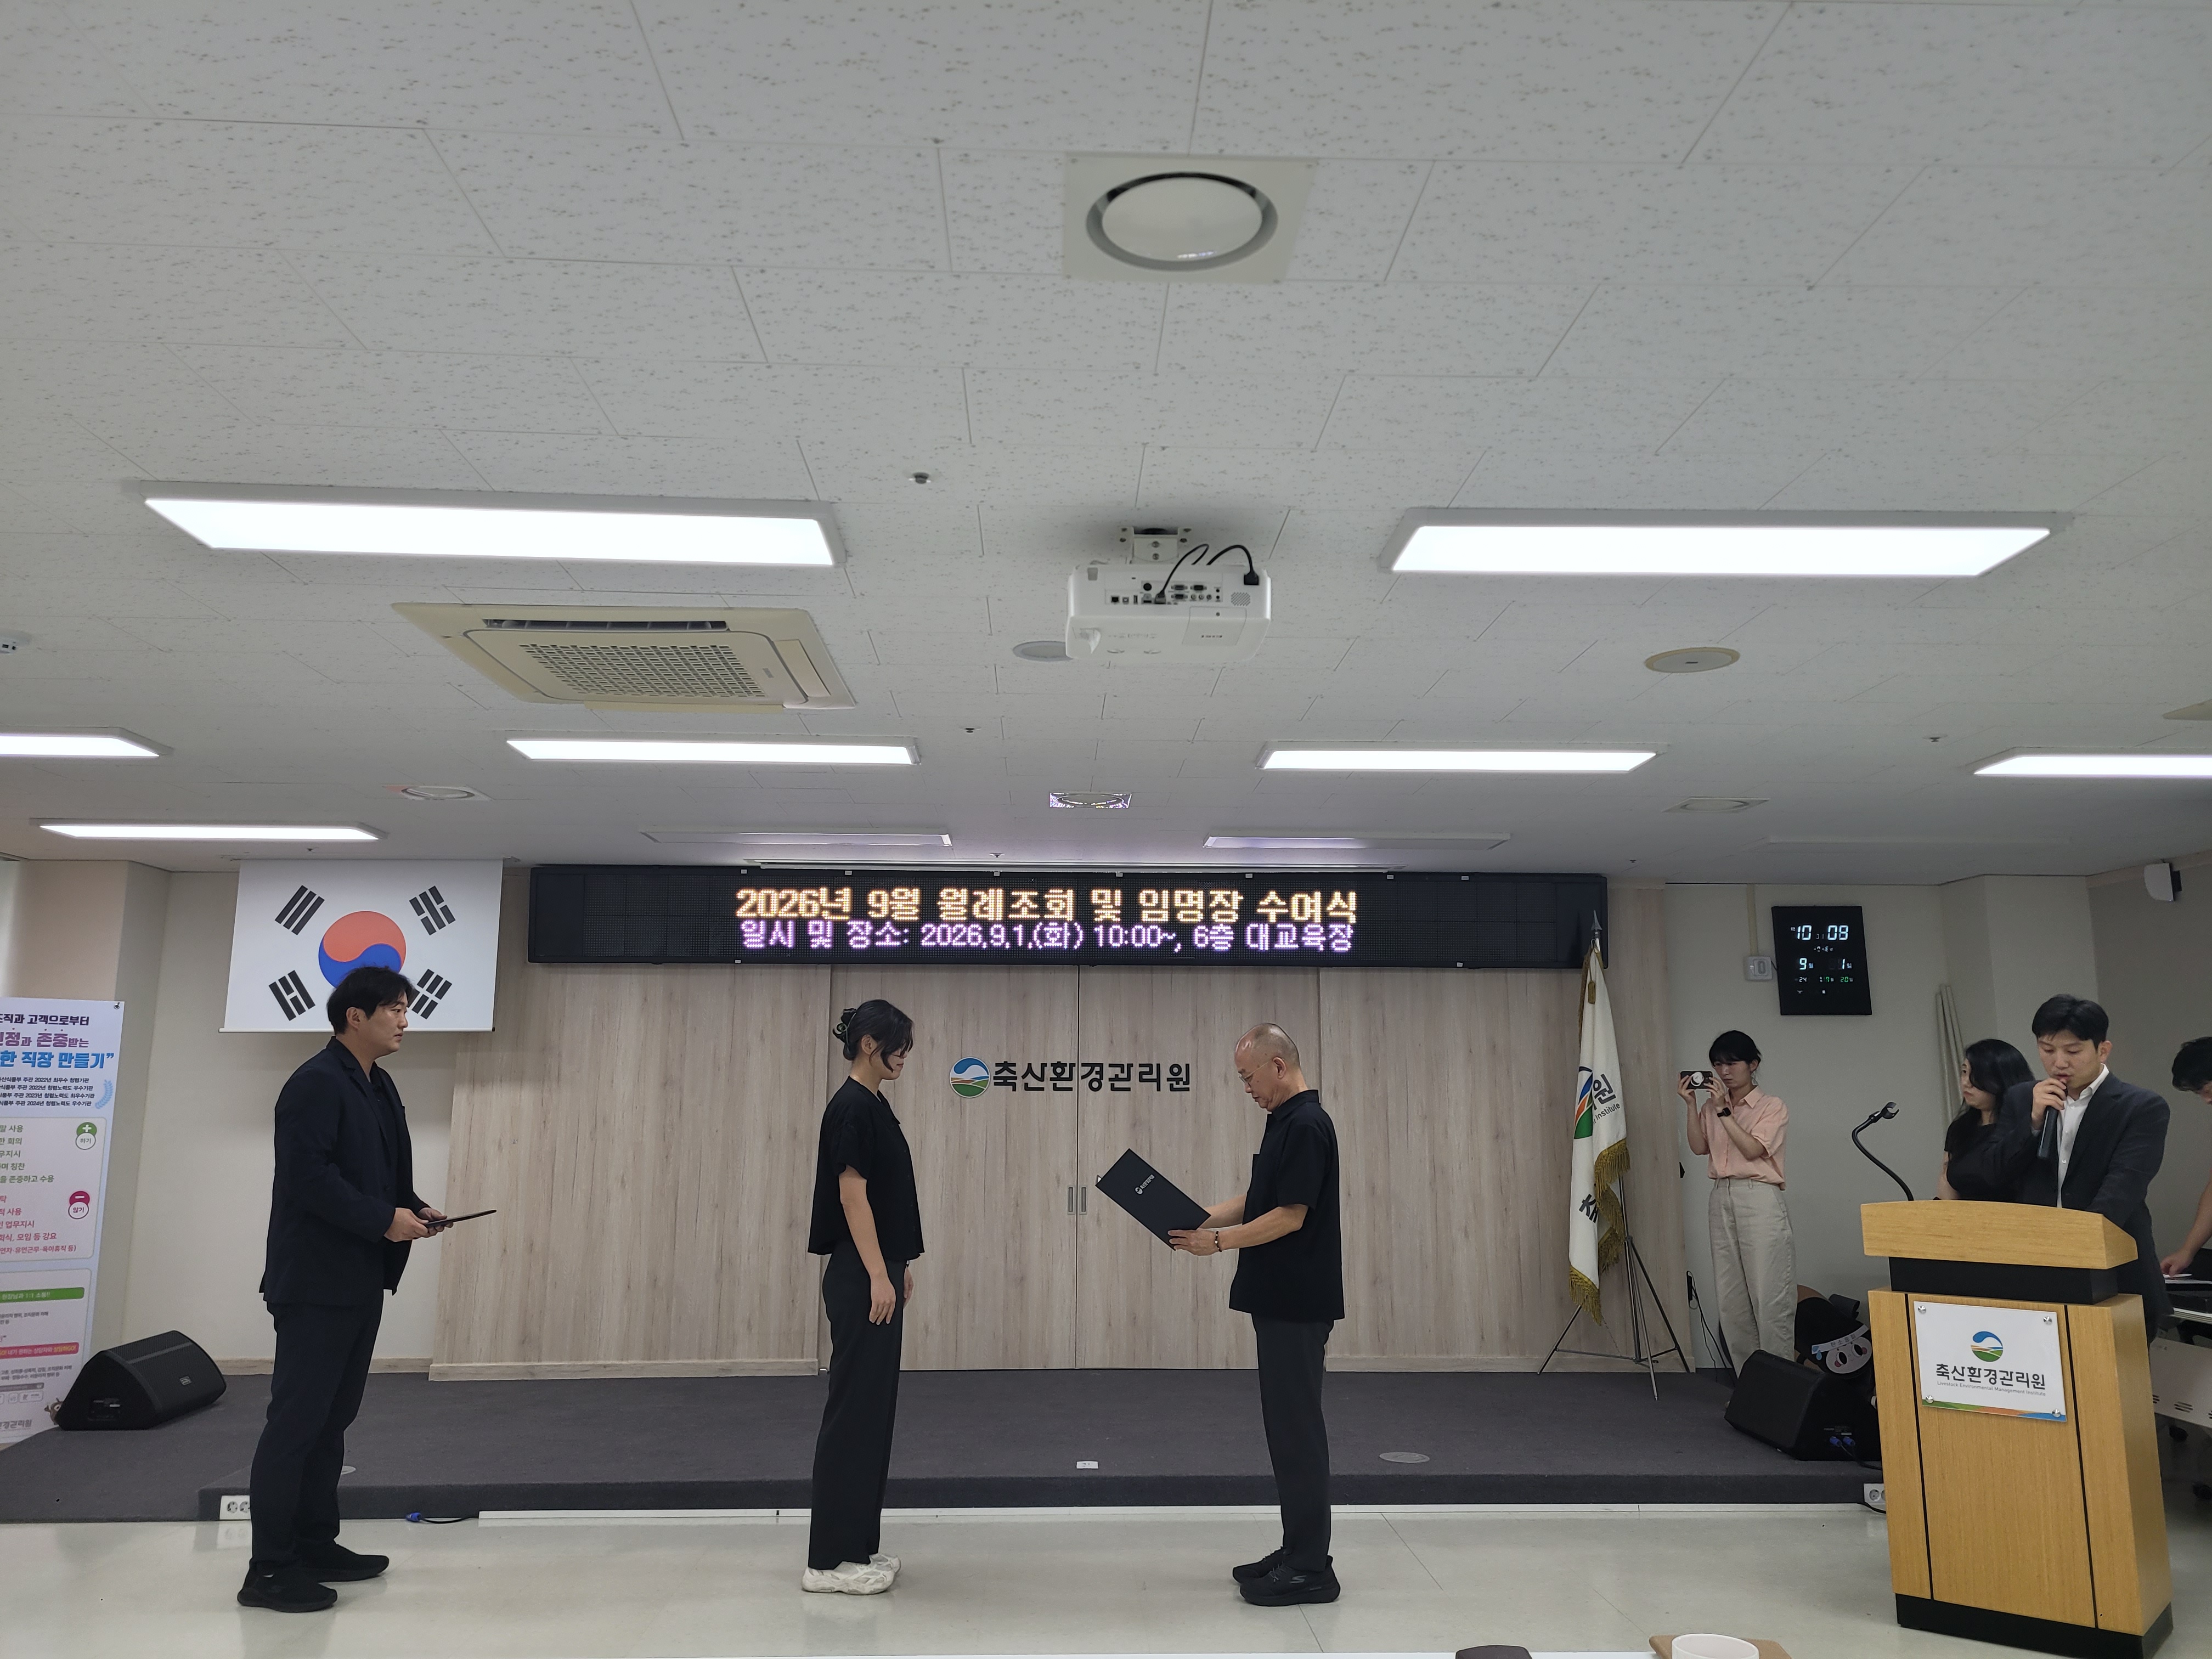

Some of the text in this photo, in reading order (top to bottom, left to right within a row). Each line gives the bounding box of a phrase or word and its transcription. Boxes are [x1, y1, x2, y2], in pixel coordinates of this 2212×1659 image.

[736, 887, 1357, 924] 2026년 9월 월례조회 및 임명장 수여식
[740, 919, 795, 949] 일시
[807, 919, 834, 950] 및
[847, 920, 910, 950] 장소:
[1193, 923, 1235, 952] 6층
[1246, 922, 1354, 952] 대교육장
[1797, 925, 1849, 940] 10 08
[27, 1014, 89, 1026] 고객으로부터
[37, 1032, 89, 1048] 존중받는
[21, 1052, 54, 1068] 직장
[992, 1060, 1191, 1092] 축산환경관리원
[1595, 1103, 1621, 1121] Institute
[7, 1207, 22, 1216] 사용
[5, 1220, 35, 1229] 업무지시
[16, 1233, 31, 1241] 모임
[42, 1232, 57, 1240] 강요
[1936, 1363, 2046, 1390] 축산환경관리원
[1959, 1383, 1994, 1391] Environmental
[1994, 1386, 2025, 1395] Management
